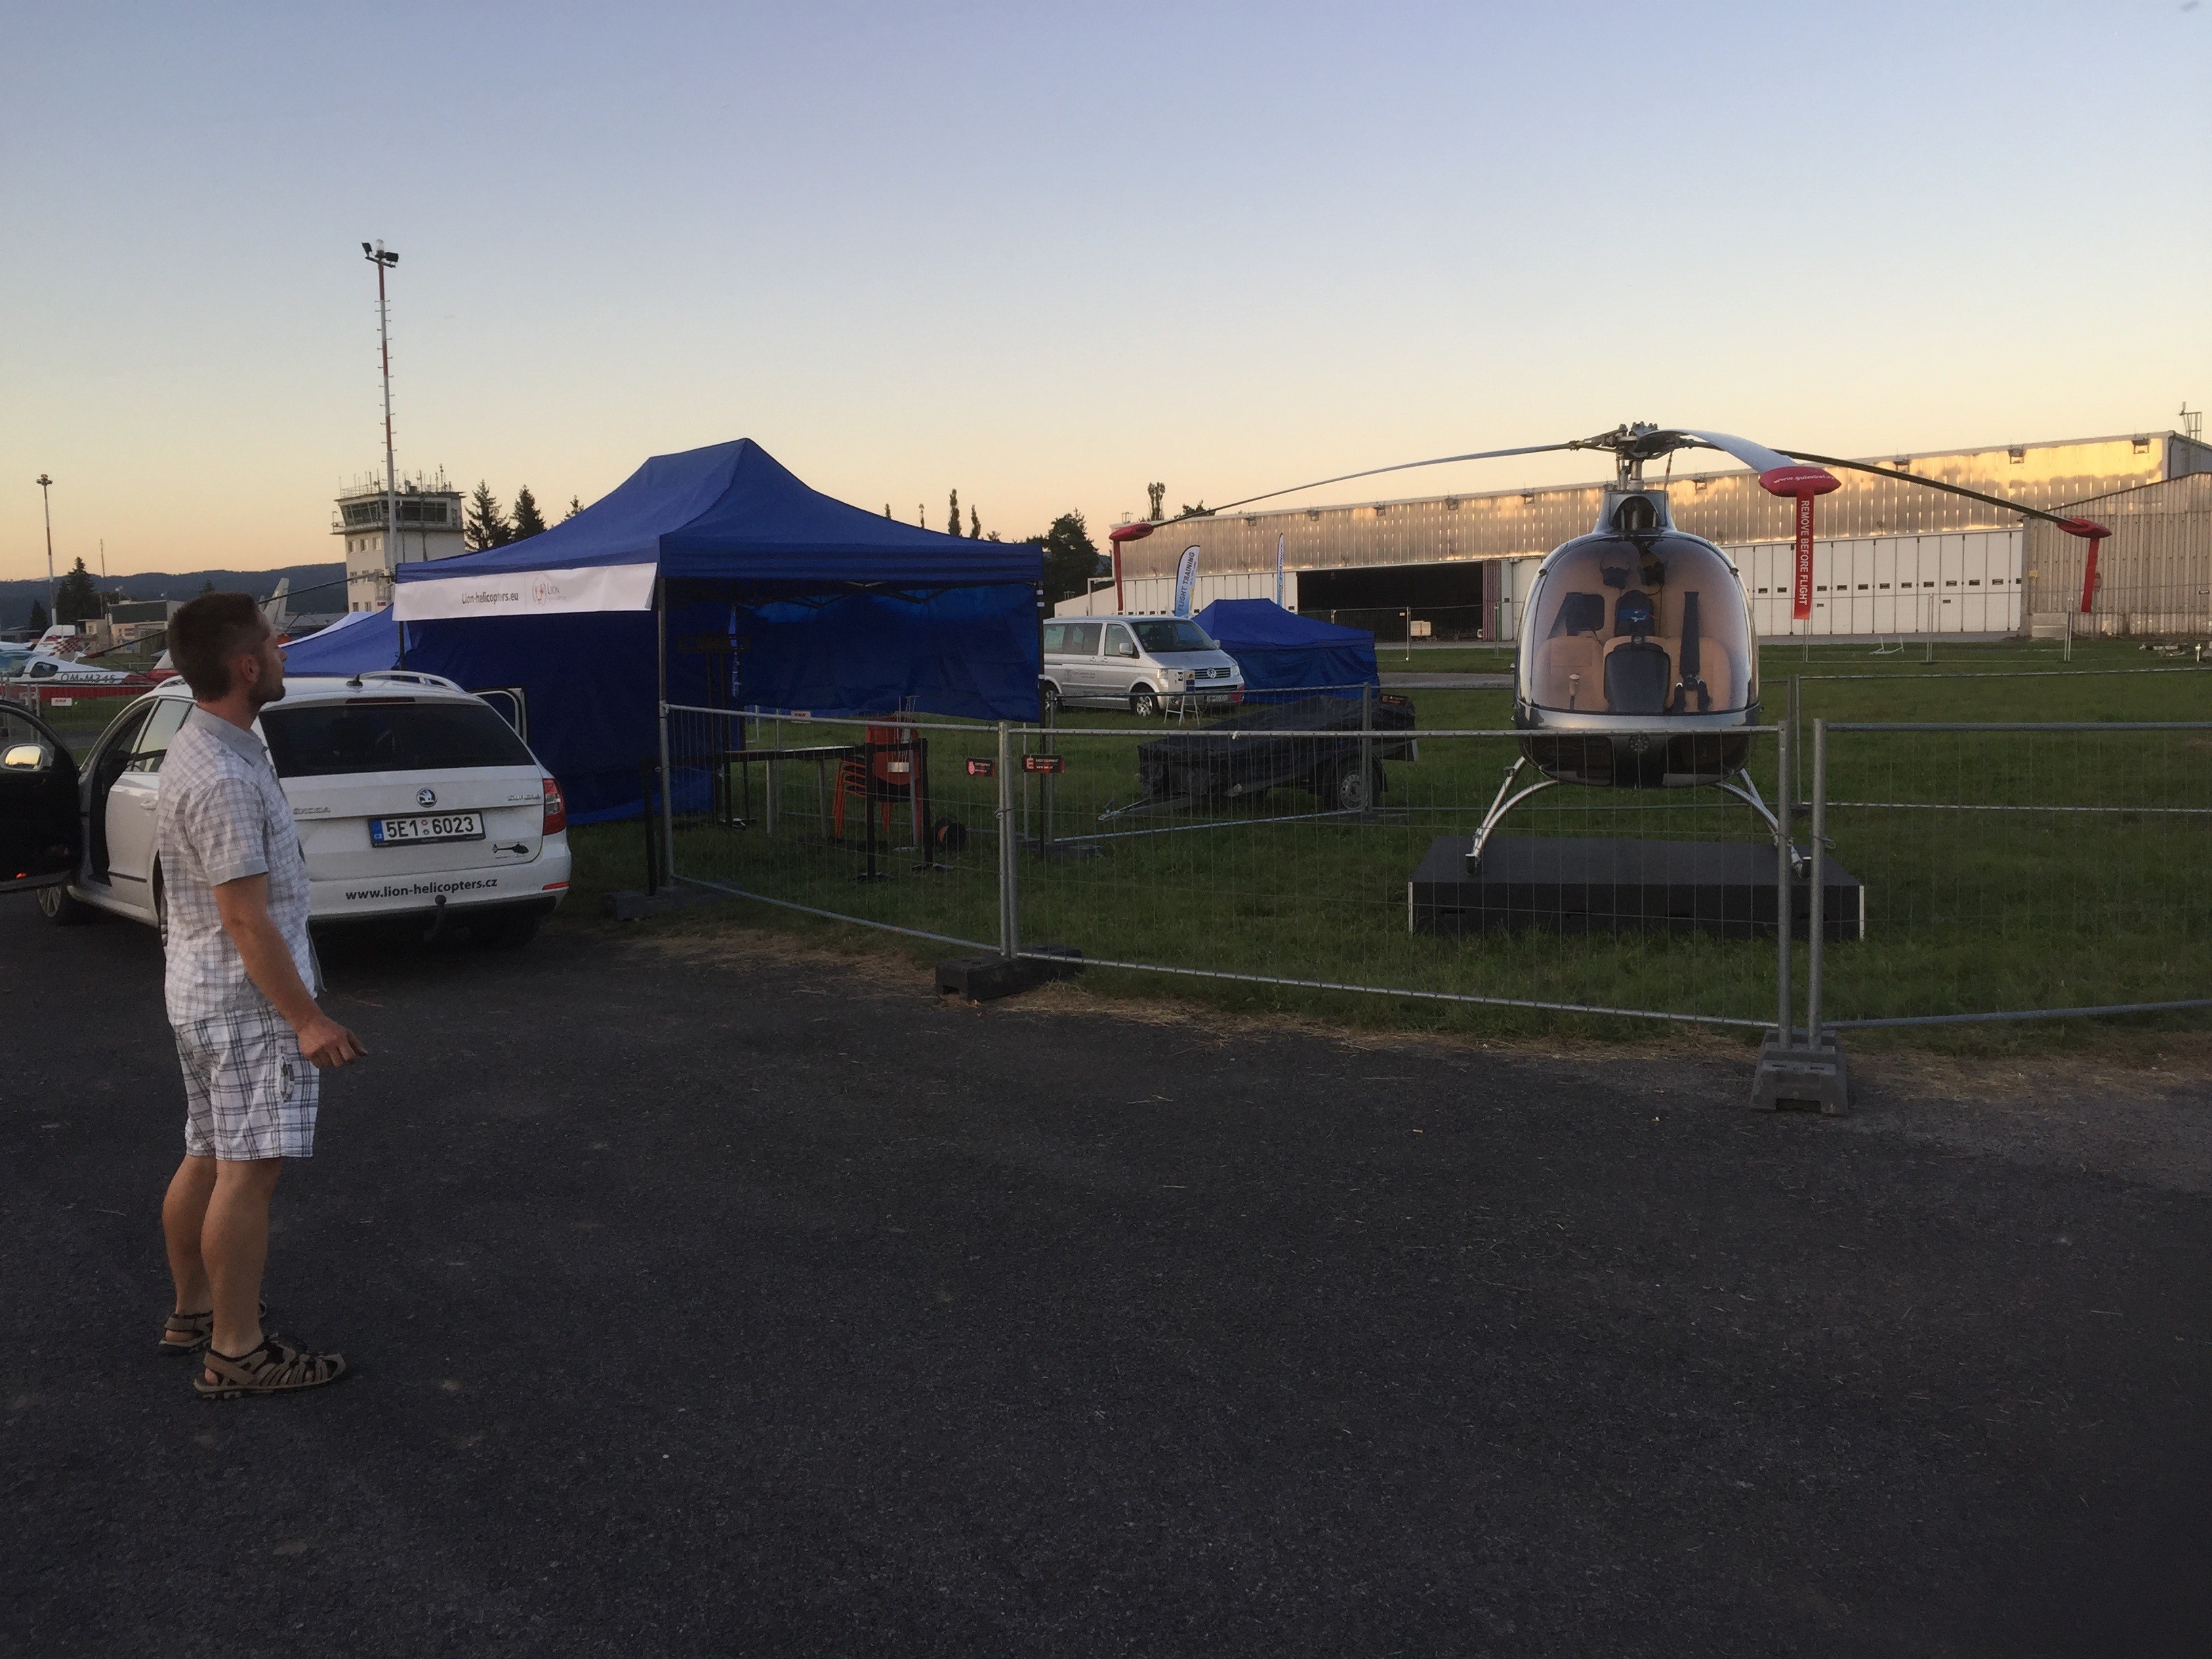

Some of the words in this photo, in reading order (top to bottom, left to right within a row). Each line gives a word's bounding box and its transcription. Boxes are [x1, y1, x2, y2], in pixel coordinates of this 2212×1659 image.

[1800, 500, 1810, 535] REMOVE
[1799, 538, 1809, 573] BEFORE
[1177, 586, 1187, 612] FLIGHT
[1182, 552, 1195, 585] TRAINING
[1799, 576, 1809, 605] FLIGHT
[386, 819, 419, 838] 5E1
[432, 816, 474, 835] 6023
[345, 878, 498, 900] www.lion-helicopters.cz
